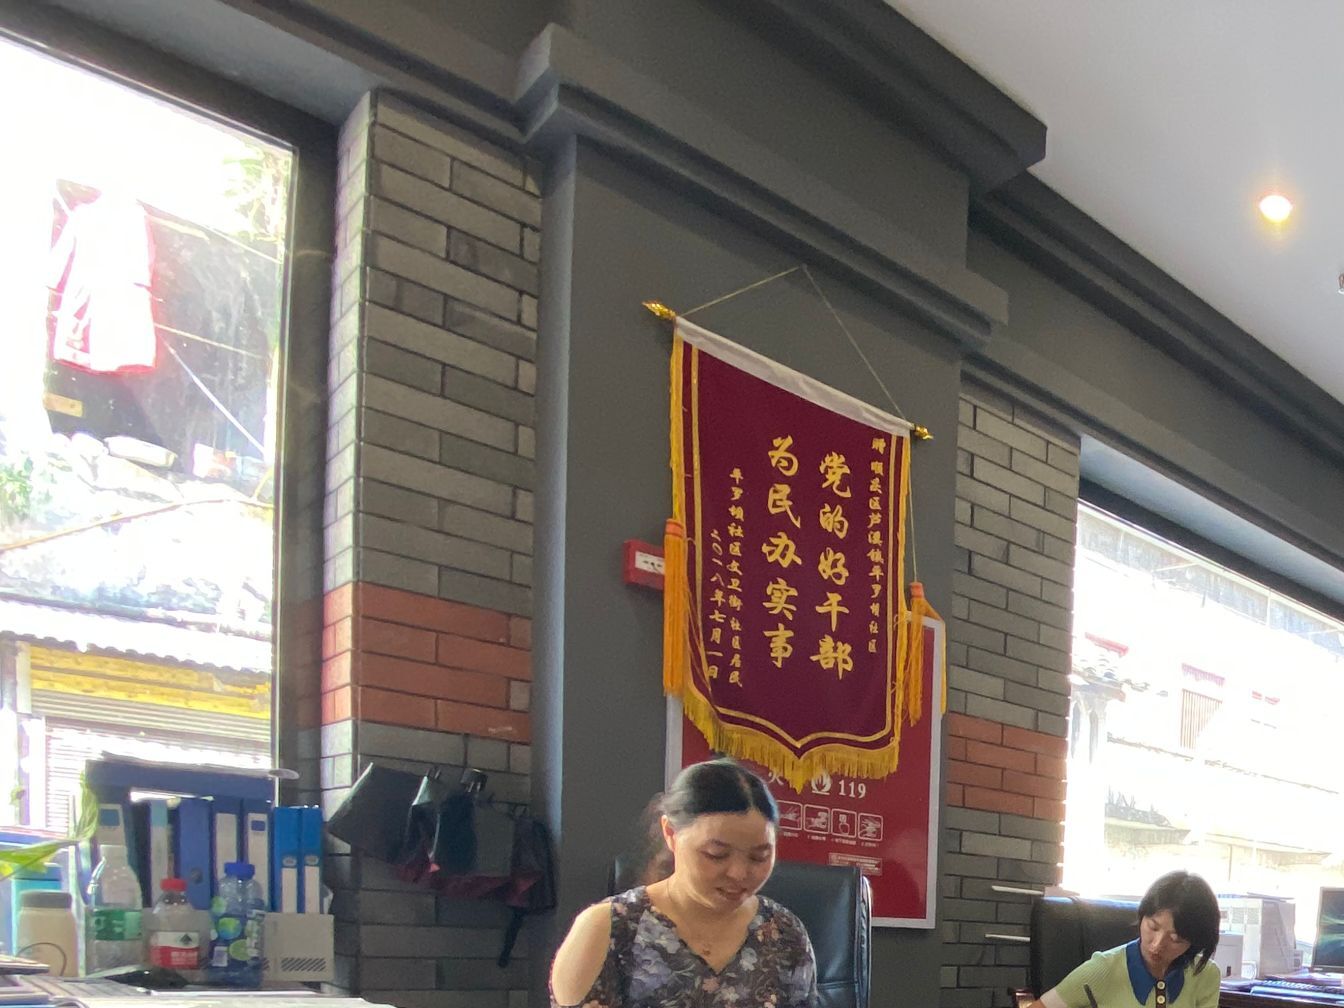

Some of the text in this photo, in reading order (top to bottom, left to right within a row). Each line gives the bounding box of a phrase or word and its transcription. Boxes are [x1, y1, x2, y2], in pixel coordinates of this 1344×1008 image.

[761, 435, 803, 669] 为民办实事
[810, 451, 854, 680] 党的好干部
[838, 780, 867, 799] 119
